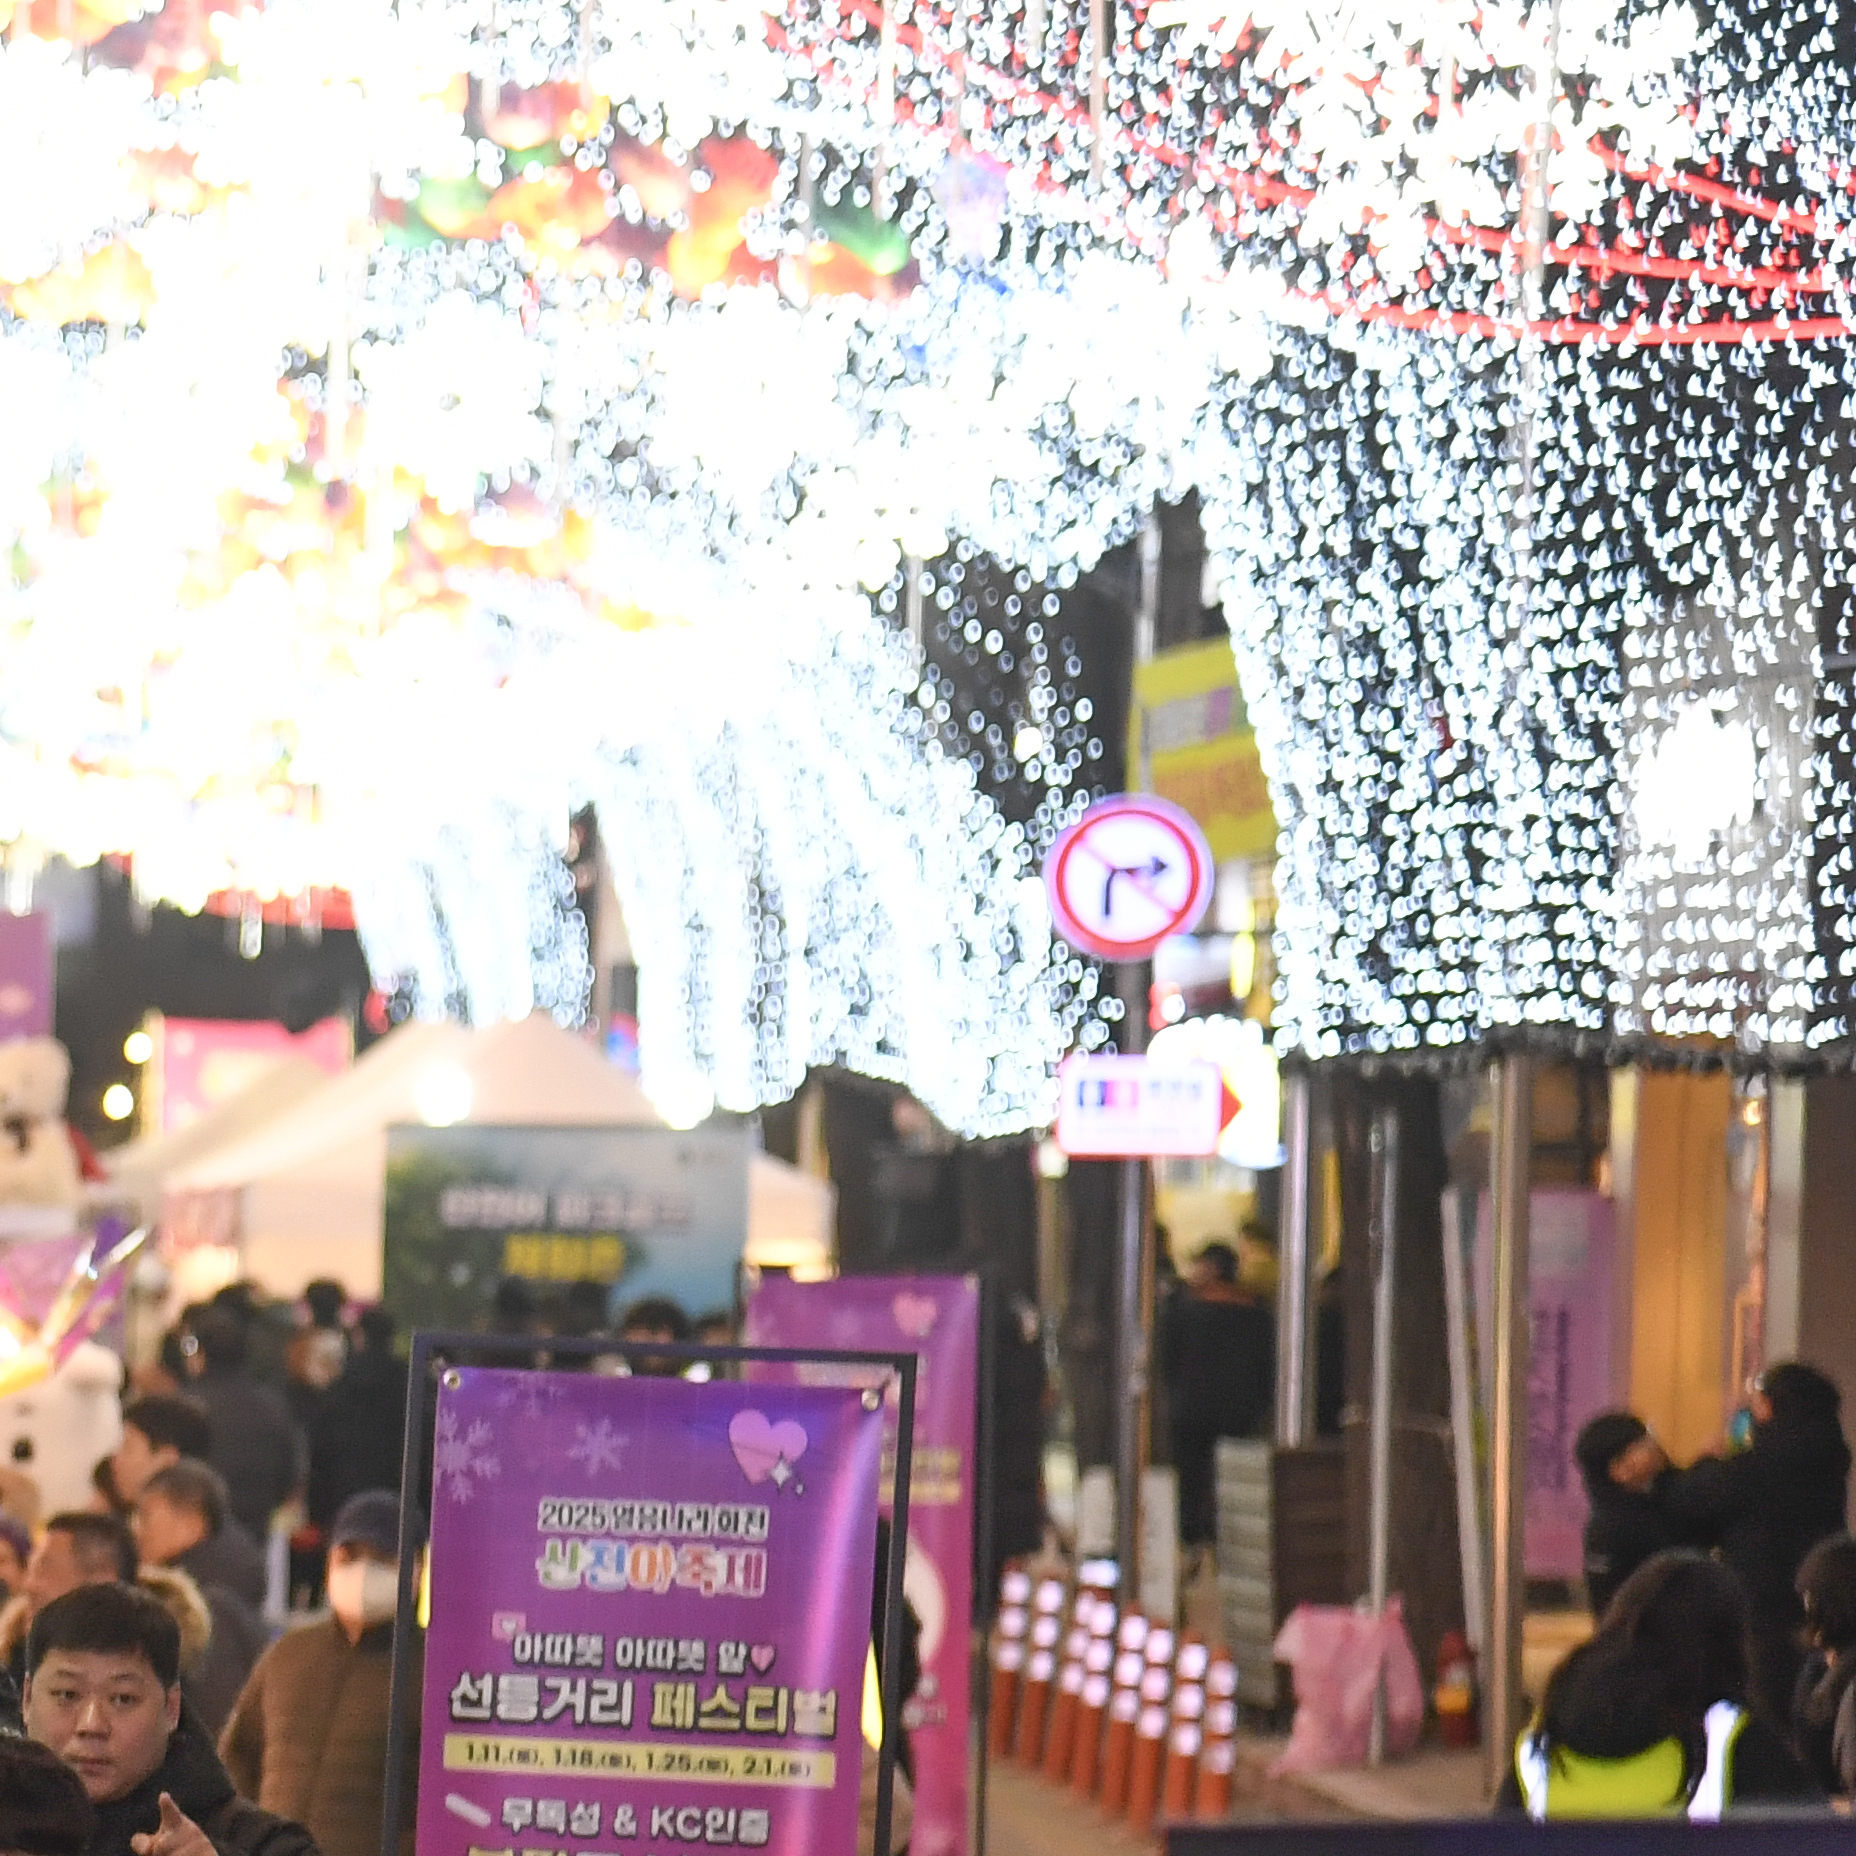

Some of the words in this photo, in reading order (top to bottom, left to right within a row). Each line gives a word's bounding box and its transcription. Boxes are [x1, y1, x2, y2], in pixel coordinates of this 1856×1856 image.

[540, 1501, 607, 1532] 2025
[450, 1672, 633, 1728] 선등거리
[651, 1682, 837, 1737] 페스티벌
[614, 1803, 636, 1838] &
